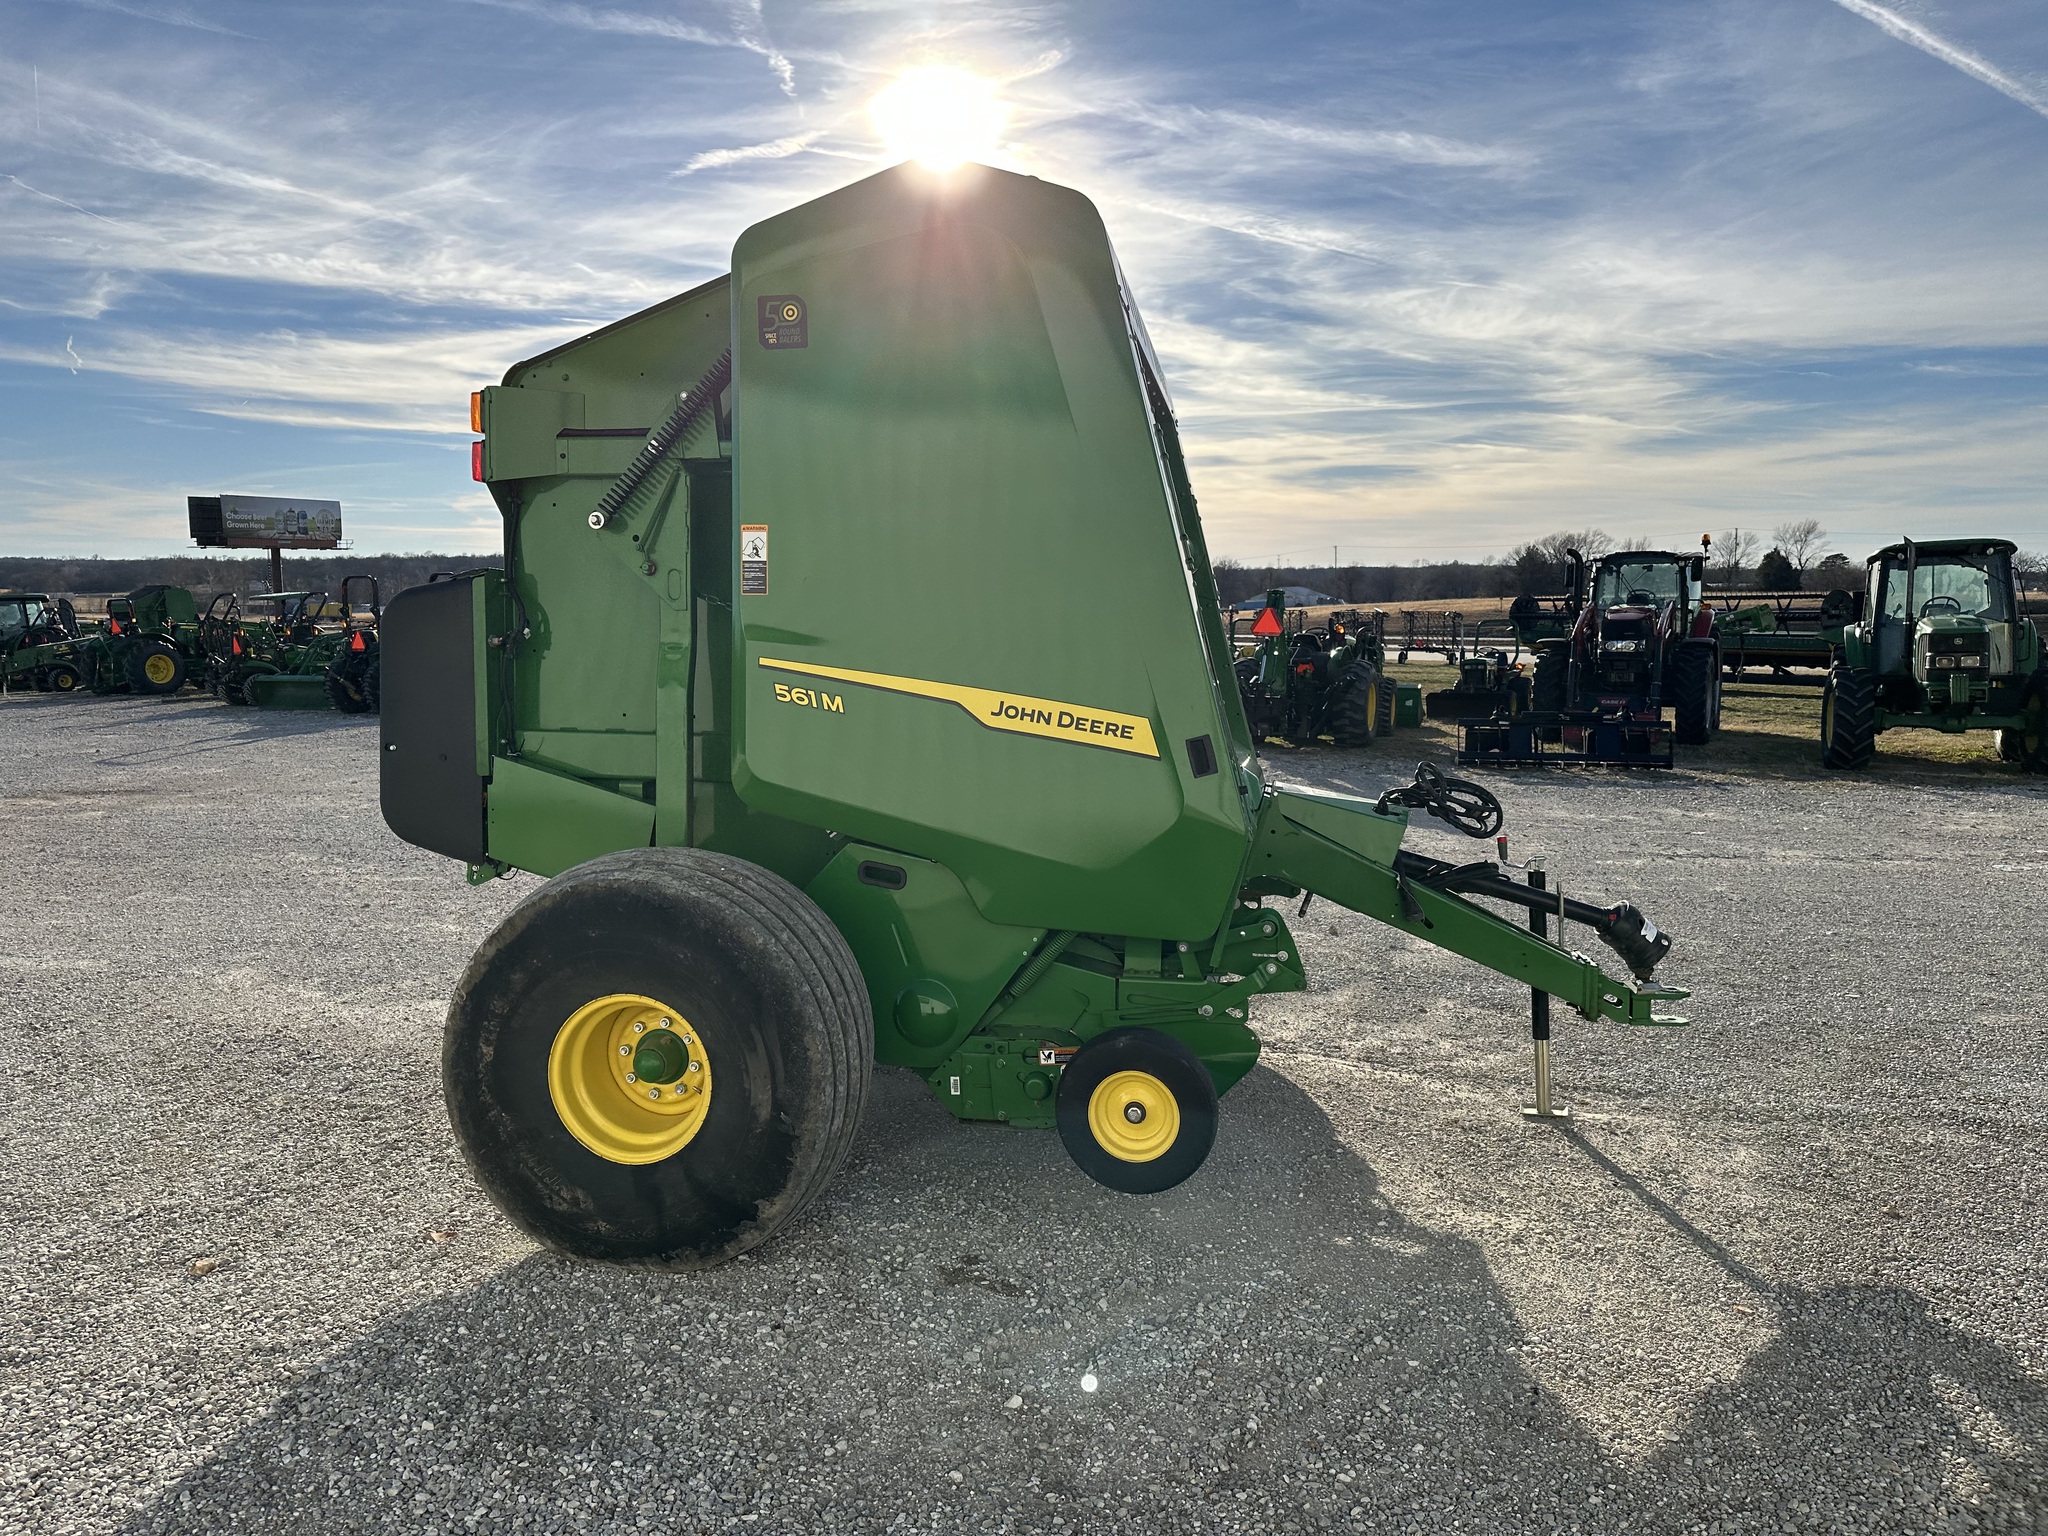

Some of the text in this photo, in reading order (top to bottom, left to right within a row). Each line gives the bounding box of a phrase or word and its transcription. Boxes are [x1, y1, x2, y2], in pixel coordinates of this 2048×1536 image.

[226, 512, 268, 521] Choose Beer
[226, 520, 249, 528] Grown
[991, 700, 1135, 740] JOHN DEERE
